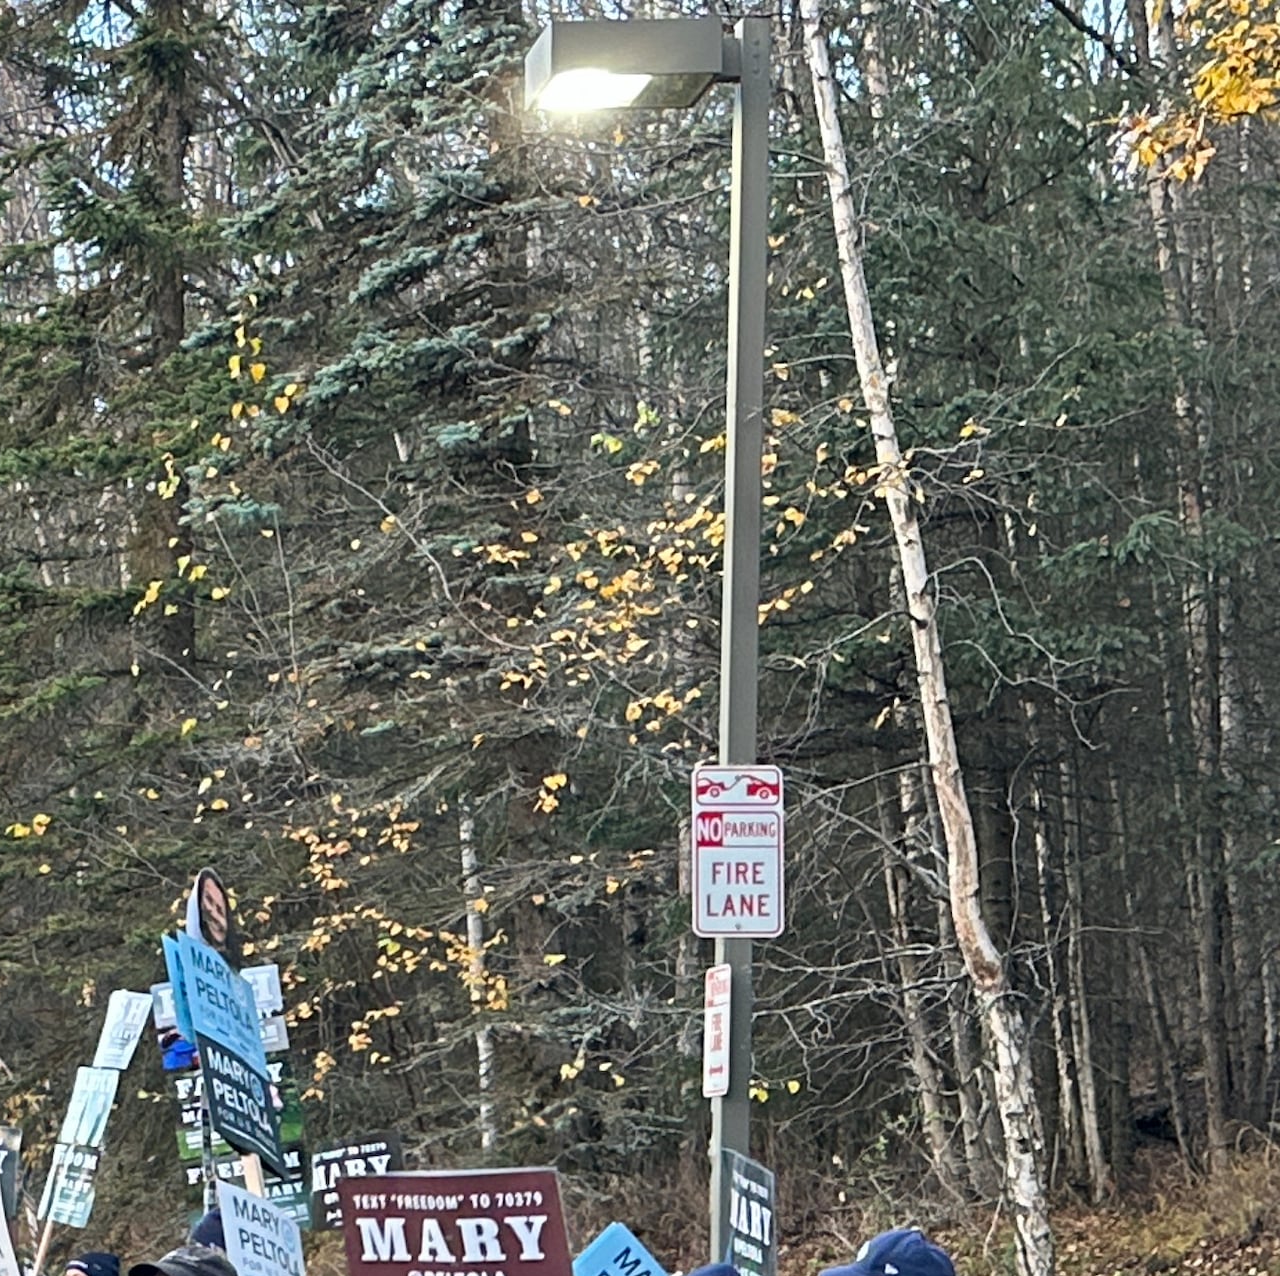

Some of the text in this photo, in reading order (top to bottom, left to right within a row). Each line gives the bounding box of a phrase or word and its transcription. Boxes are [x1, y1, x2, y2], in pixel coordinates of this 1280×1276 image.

[697, 818, 777, 843] NO PARKING
[712, 862, 765, 885] FIRE
[707, 894, 771, 917] LANE
[207, 1046, 250, 1089] MARY
[212, 1078, 274, 1137] PELTOLA
[233, 1195, 280, 1235] MARY
[353, 1194, 386, 1210] TEXT
[470, 1194, 490, 1208] TO
[495, 1191, 543, 1208] 70379
[355, 1215, 548, 1263] MARY
